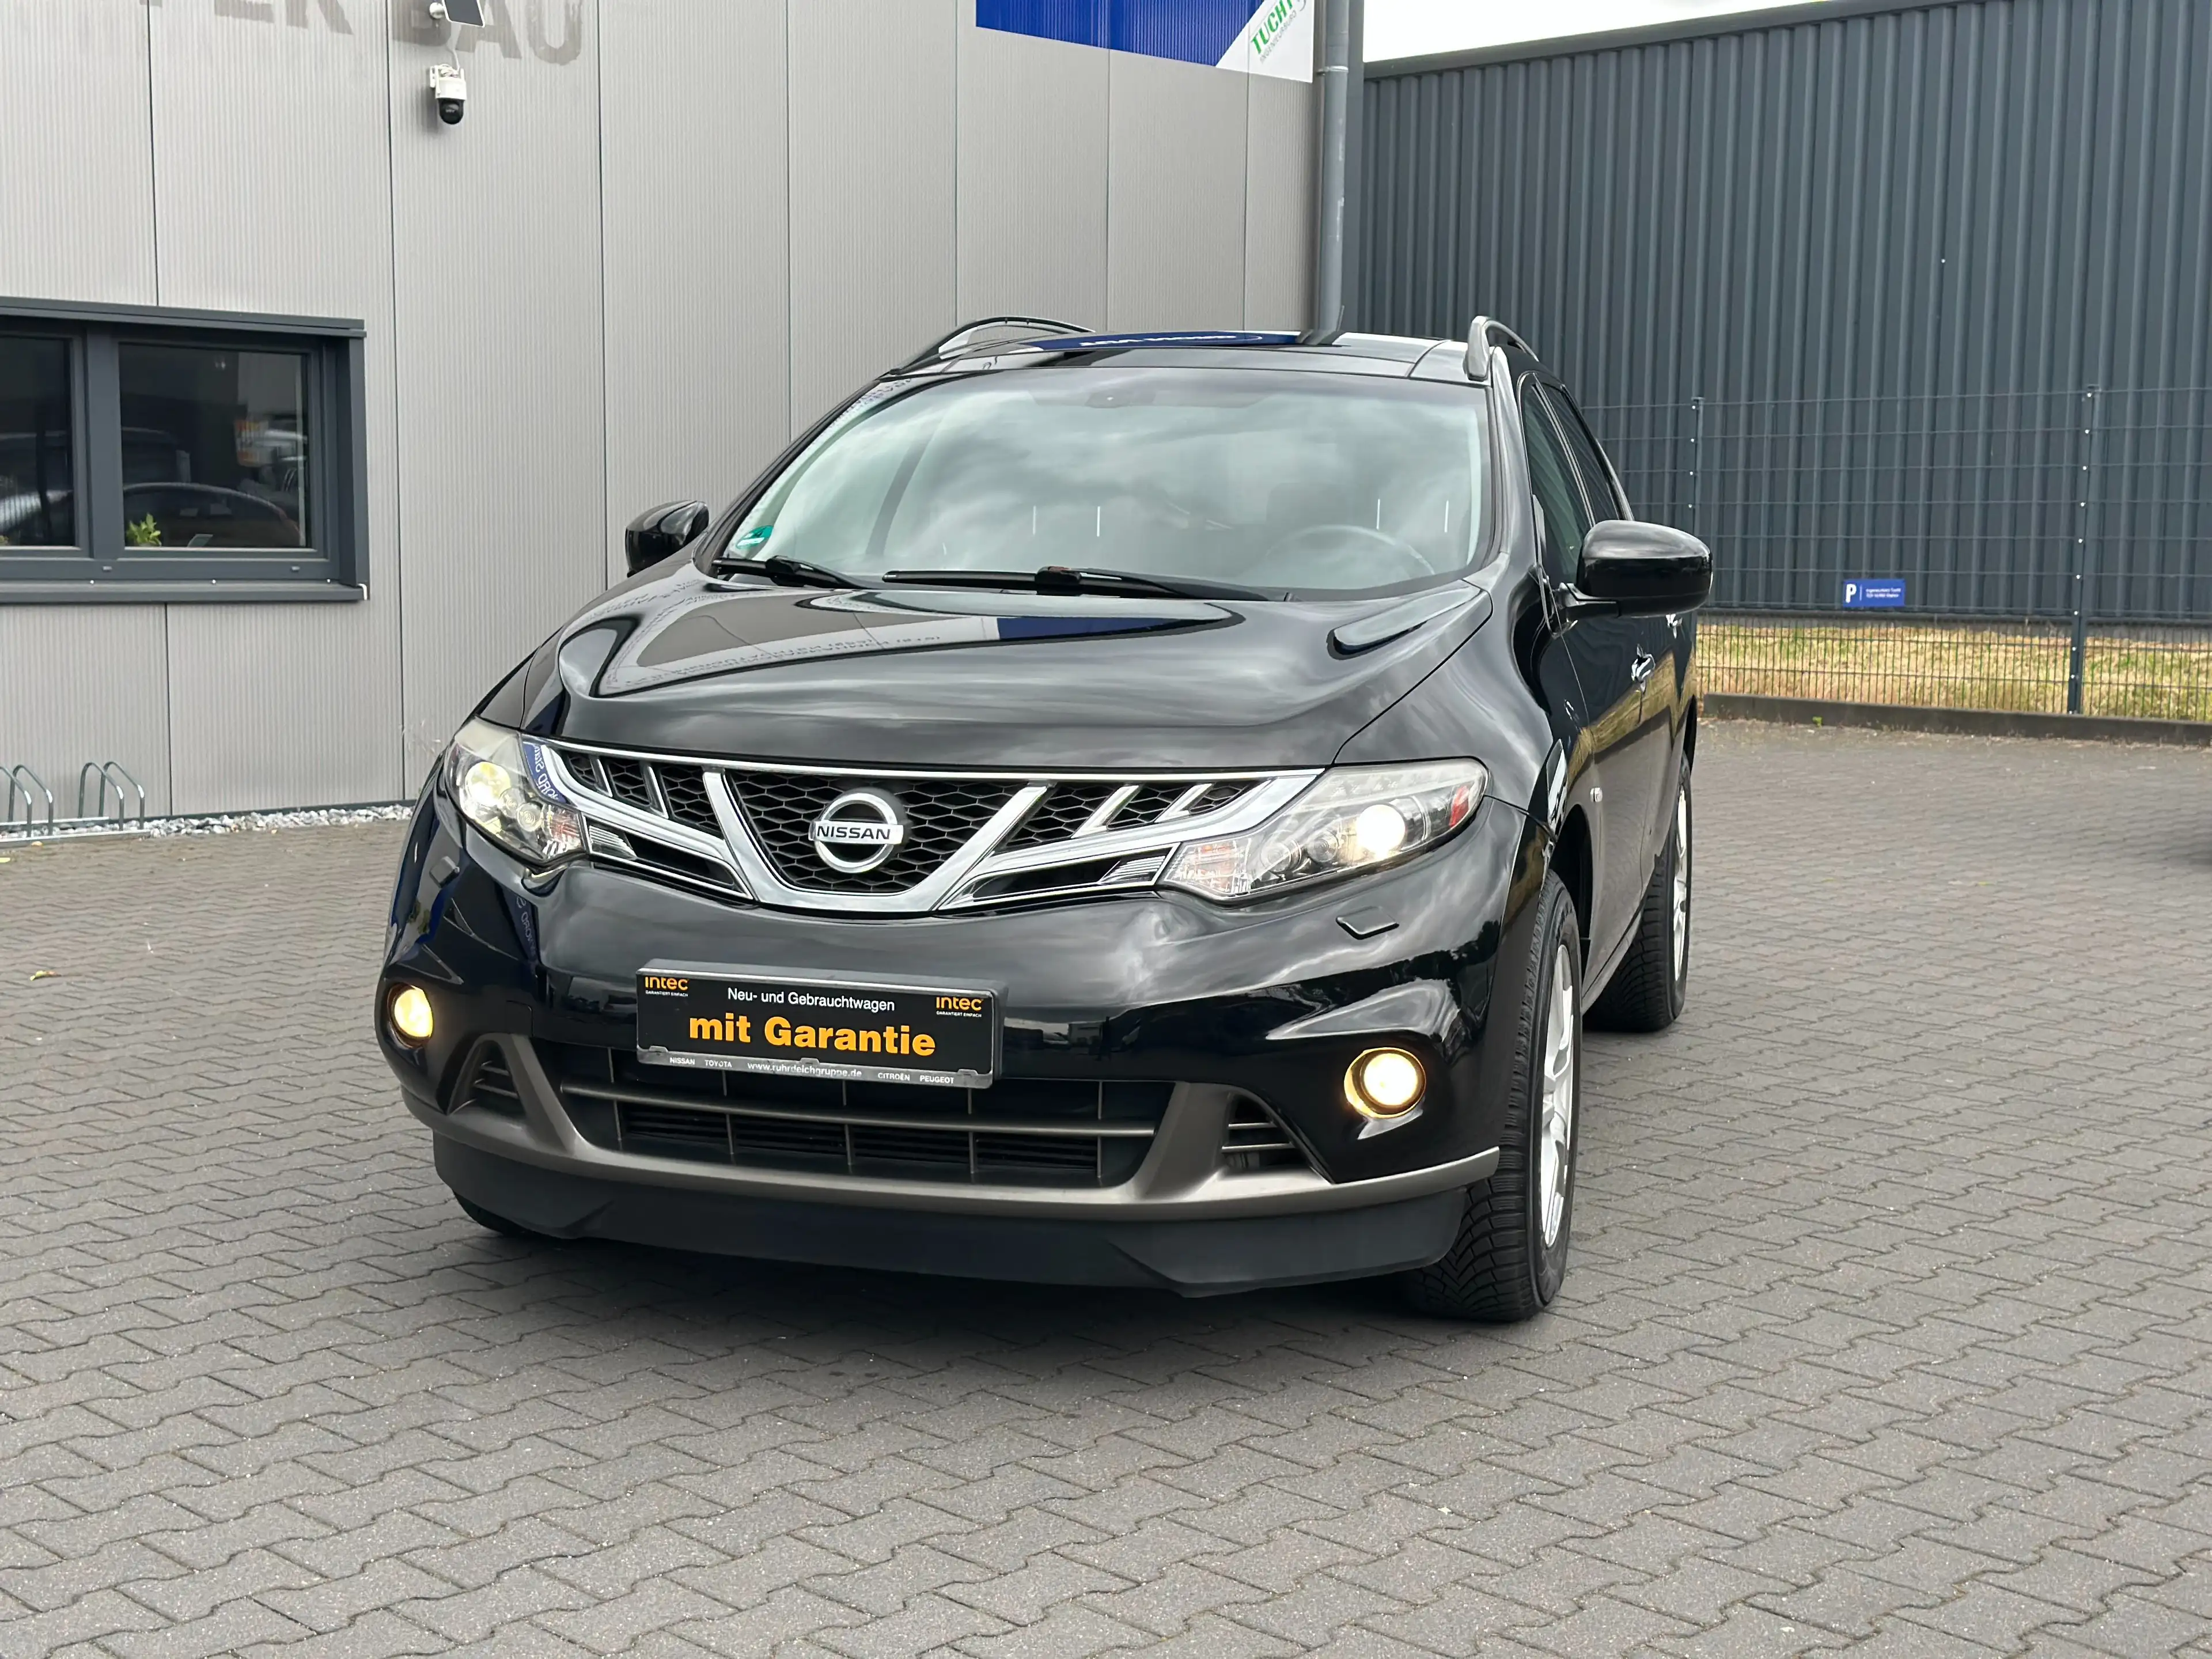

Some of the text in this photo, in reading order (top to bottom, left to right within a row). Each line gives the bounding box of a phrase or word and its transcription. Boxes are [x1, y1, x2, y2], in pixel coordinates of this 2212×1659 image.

[817, 825, 891, 840] NISSAN
[645, 976, 688, 991] intec
[728, 987, 895, 1013] Neu- und Gebrauchtwagen
[936, 997, 982, 1011] intec
[690, 1012, 935, 1056] mit Garantie
[669, 1057, 695, 1065] NISSAN
[704, 1059, 732, 1068] TOYOTA
[919, 1074, 955, 1084] PEUGEOT
